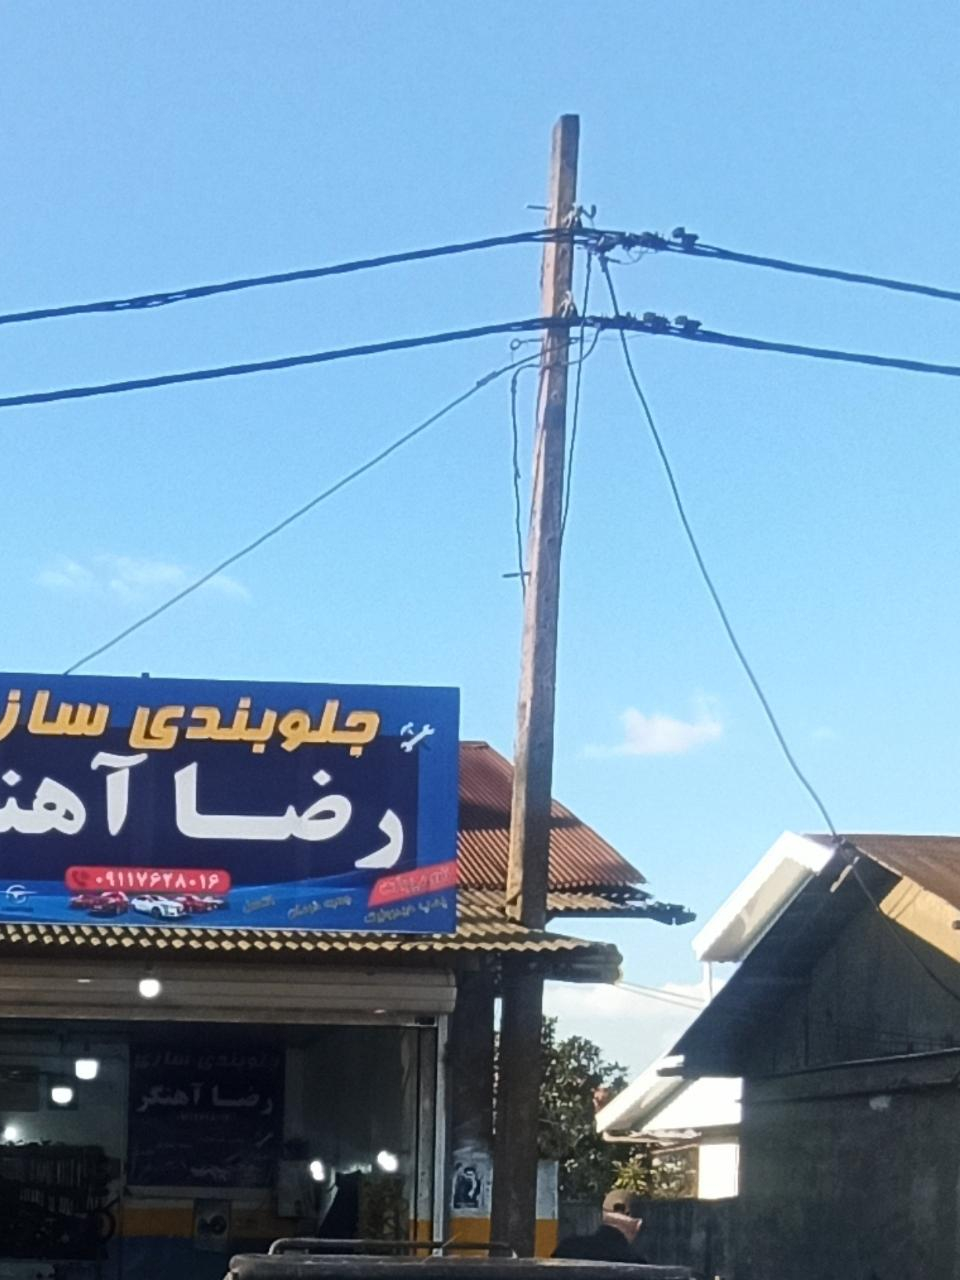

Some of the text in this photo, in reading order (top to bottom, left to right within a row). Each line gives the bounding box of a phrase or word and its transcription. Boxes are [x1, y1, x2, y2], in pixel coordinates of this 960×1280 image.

[129, 696, 380, 758] جلوبندی
[173, 761, 404, 870] رضا
[136, 1082, 273, 1115] رضا آهنگر
